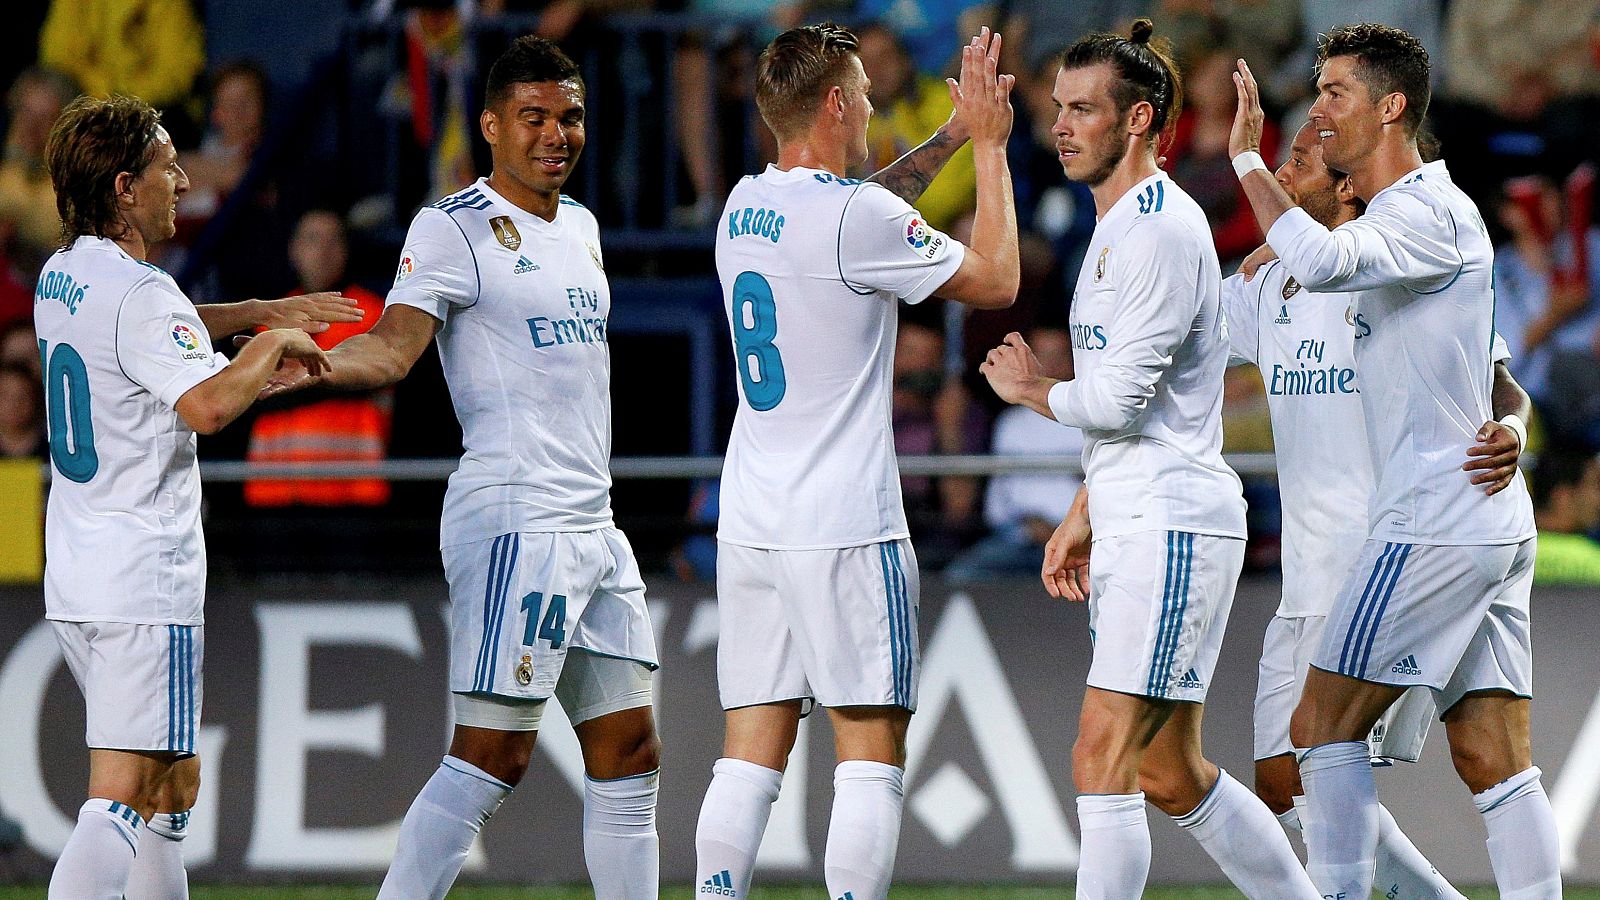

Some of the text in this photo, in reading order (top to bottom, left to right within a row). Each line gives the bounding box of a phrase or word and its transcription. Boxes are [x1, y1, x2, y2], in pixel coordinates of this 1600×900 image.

[728, 207, 785, 243] KROOS
[513, 264, 541, 275] adidas
[565, 287, 598, 313] Fly
[525, 310, 607, 348] Emira
[732, 270, 786, 412] 8
[1296, 339, 1325, 364] Fly
[520, 591, 567, 649] 14
[1391, 666, 1422, 676] adidas
[701, 886, 737, 897] adidas
